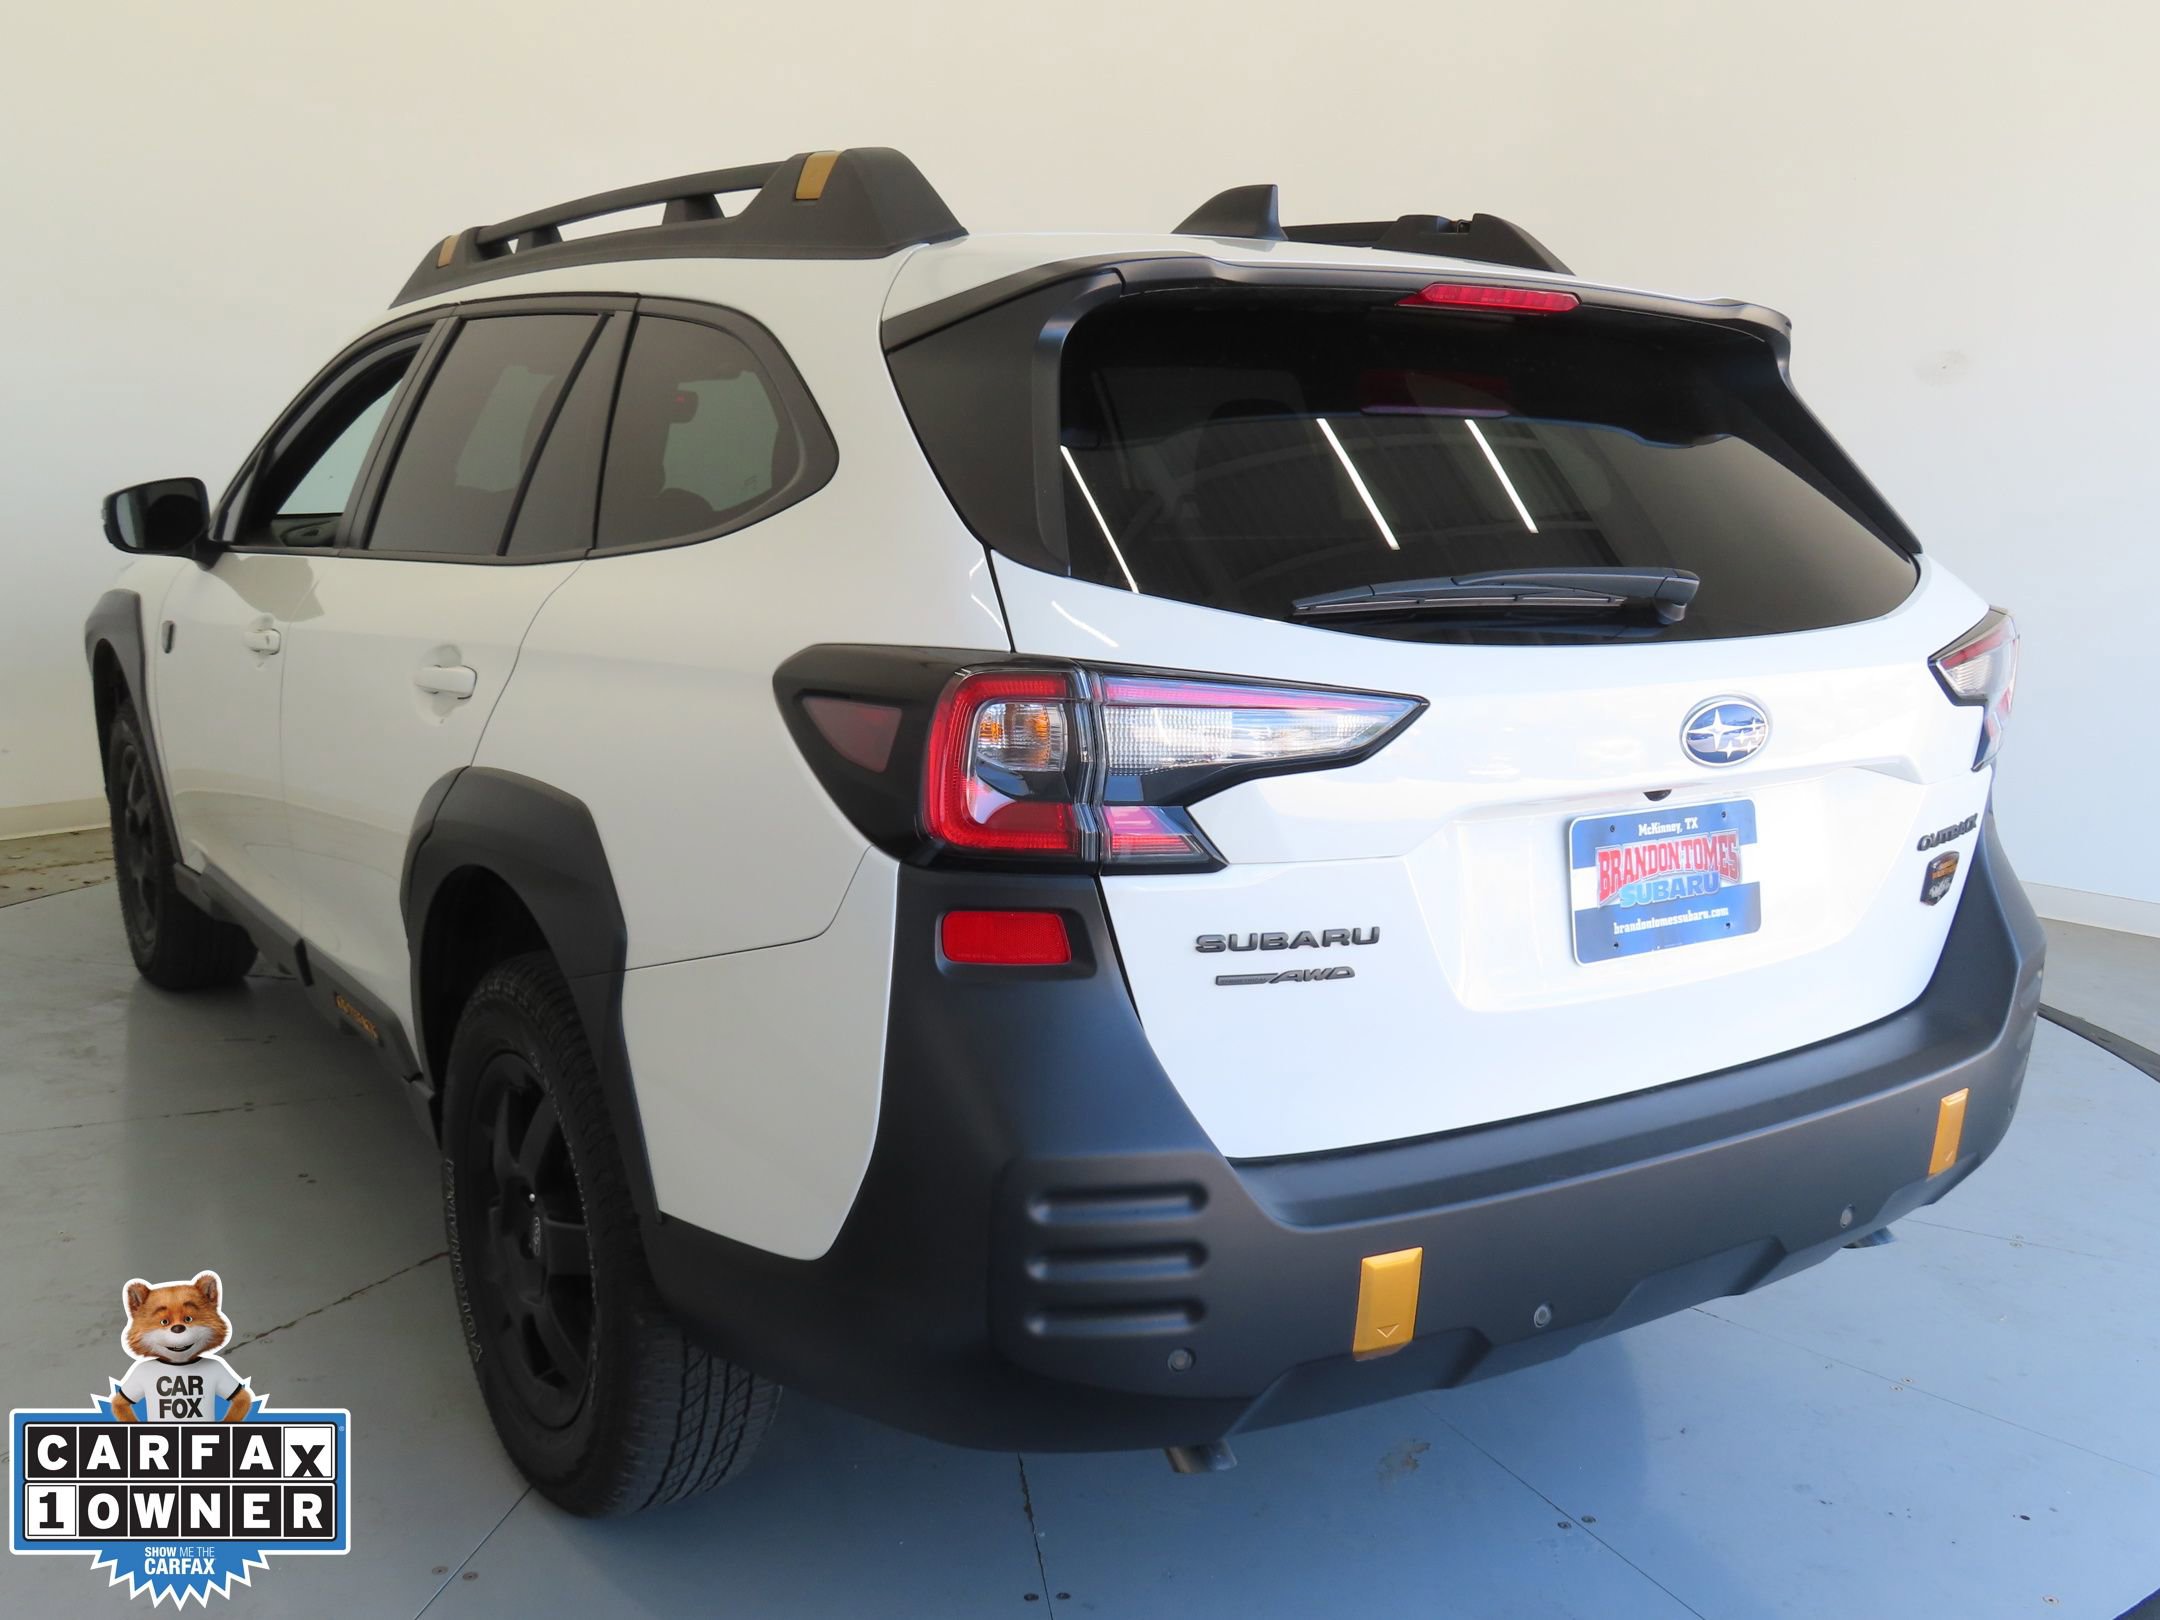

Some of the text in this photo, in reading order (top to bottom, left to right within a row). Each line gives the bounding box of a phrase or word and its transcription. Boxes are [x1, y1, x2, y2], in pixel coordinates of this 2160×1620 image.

[1638, 817, 1699, 836] McKinney, TX
[1598, 832, 1740, 902] BRANDON TOMES
[1619, 871, 1720, 907] SUBARU
[1613, 907, 1729, 935] brandontomessubaru.com
[1195, 926, 1380, 953] SUBARU
[1269, 966, 1355, 984] AWD
